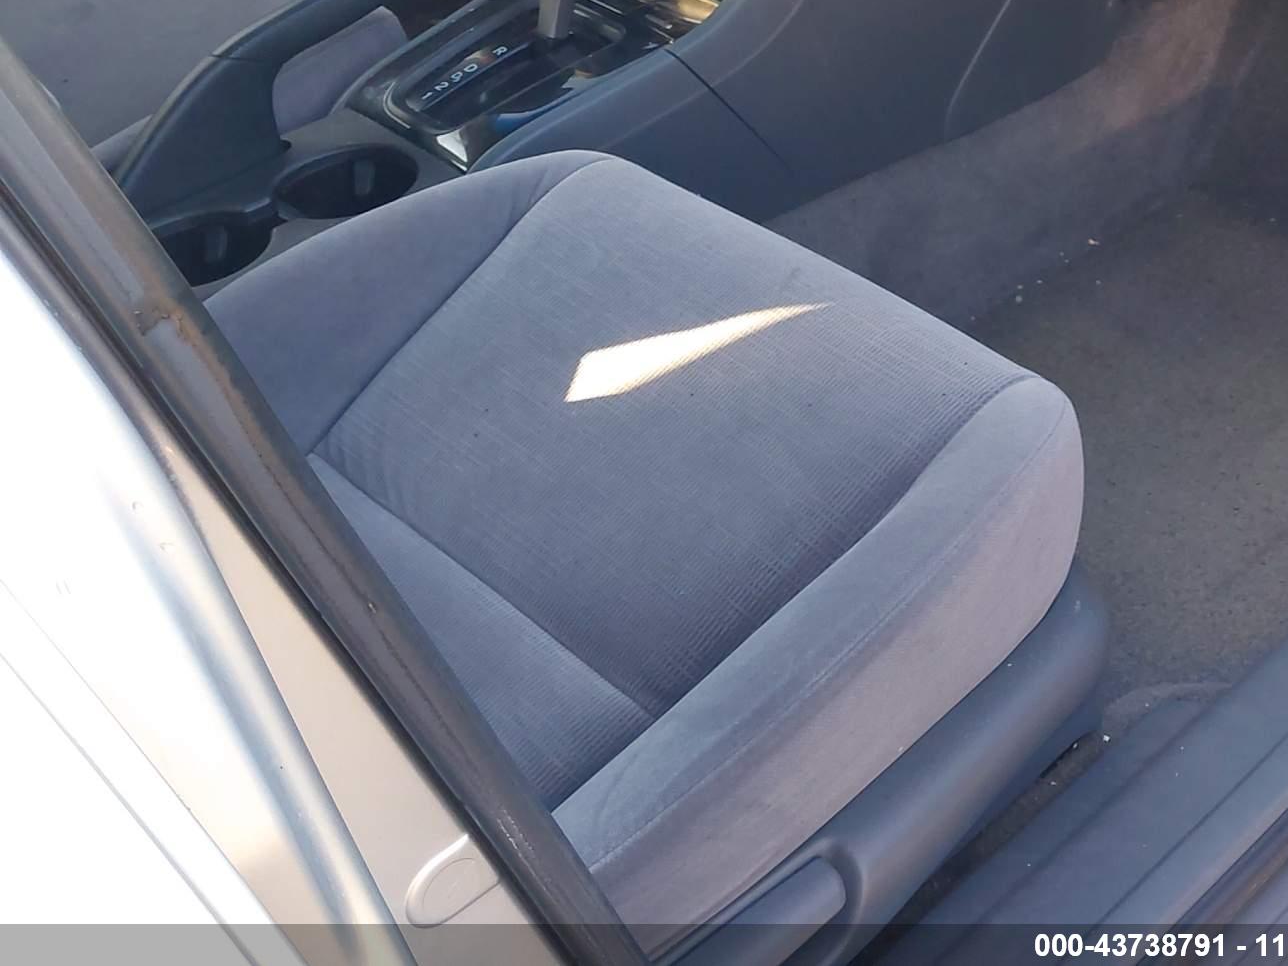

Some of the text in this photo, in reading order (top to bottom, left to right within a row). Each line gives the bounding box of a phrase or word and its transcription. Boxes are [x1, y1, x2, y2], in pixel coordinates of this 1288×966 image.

[492, 46, 508, 56] R
[463, 63, 478, 73] D
[434, 81, 449, 91] 2
